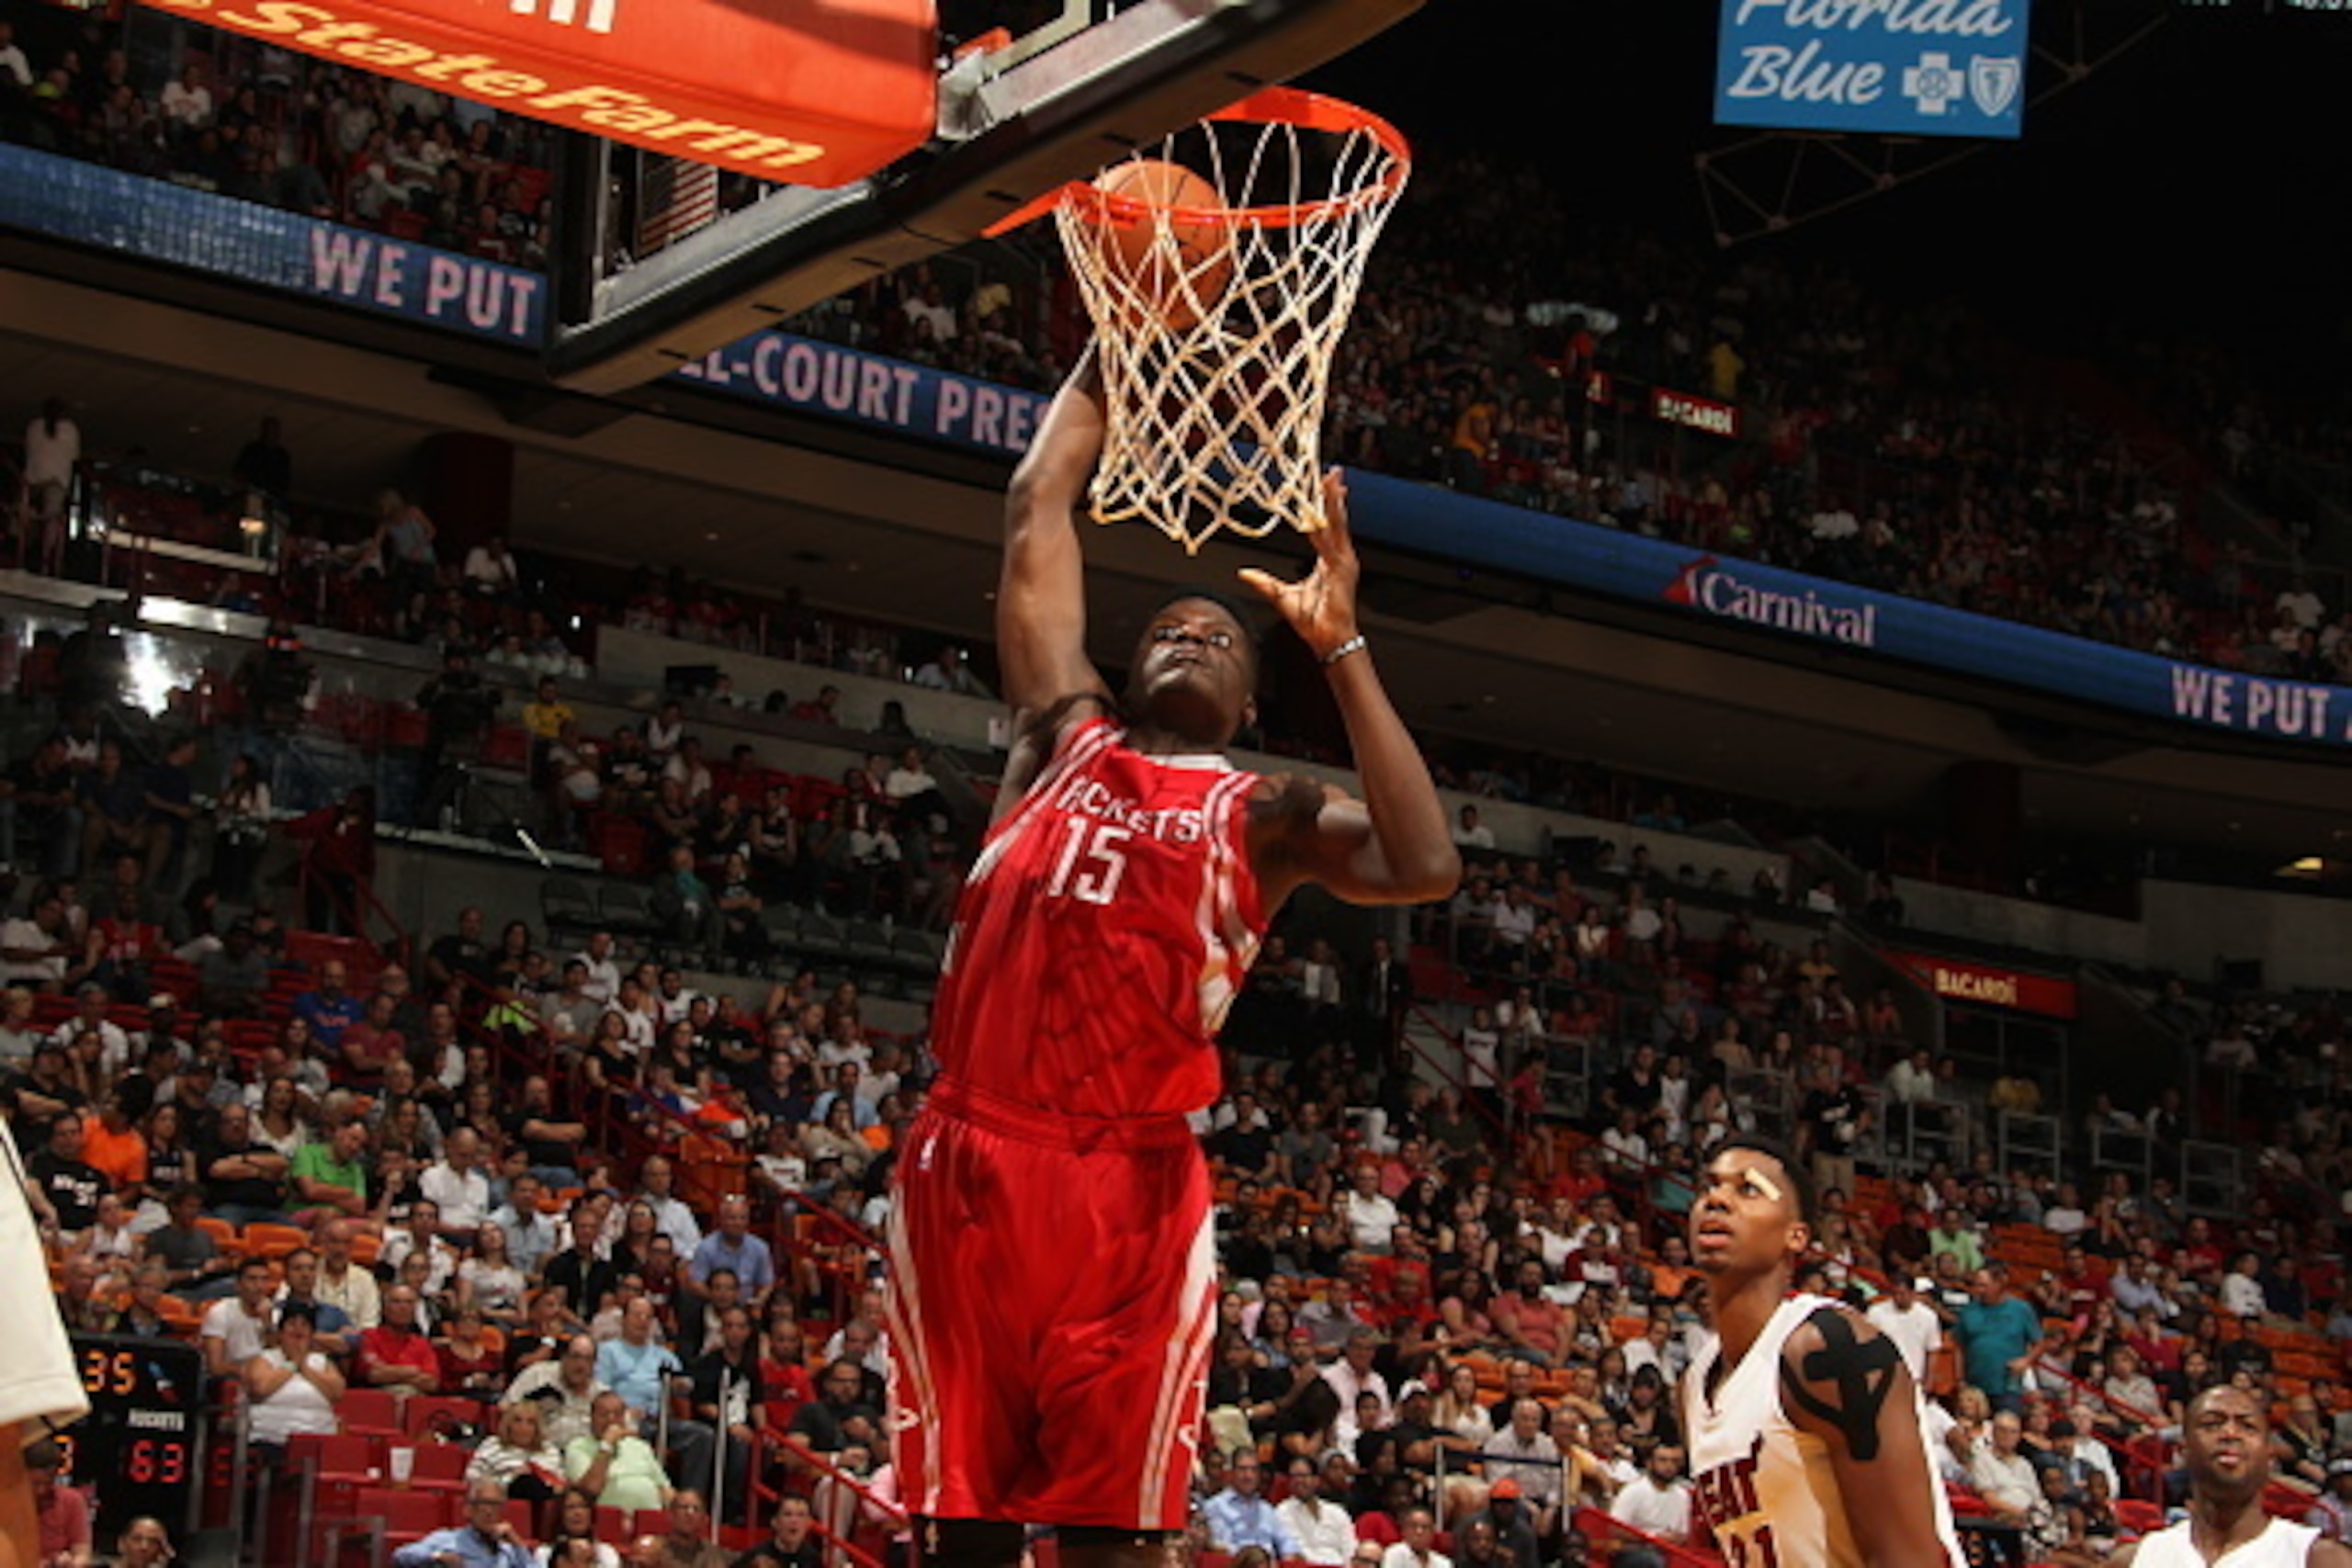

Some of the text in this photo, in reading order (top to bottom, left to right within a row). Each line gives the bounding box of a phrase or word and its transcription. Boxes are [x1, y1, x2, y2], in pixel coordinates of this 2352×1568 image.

[1727, 39, 1884, 104] Blue
[311, 226, 537, 335] WE PUT
[679, 335, 918, 426] L-COURT
[1702, 570, 1876, 647] Carnival
[2172, 664, 2233, 725] WE
[2247, 679, 2330, 738] PUT
[1047, 816, 1133, 905] 15
[85, 1350, 136, 1394] 35
[130, 1439, 184, 1483] 63
